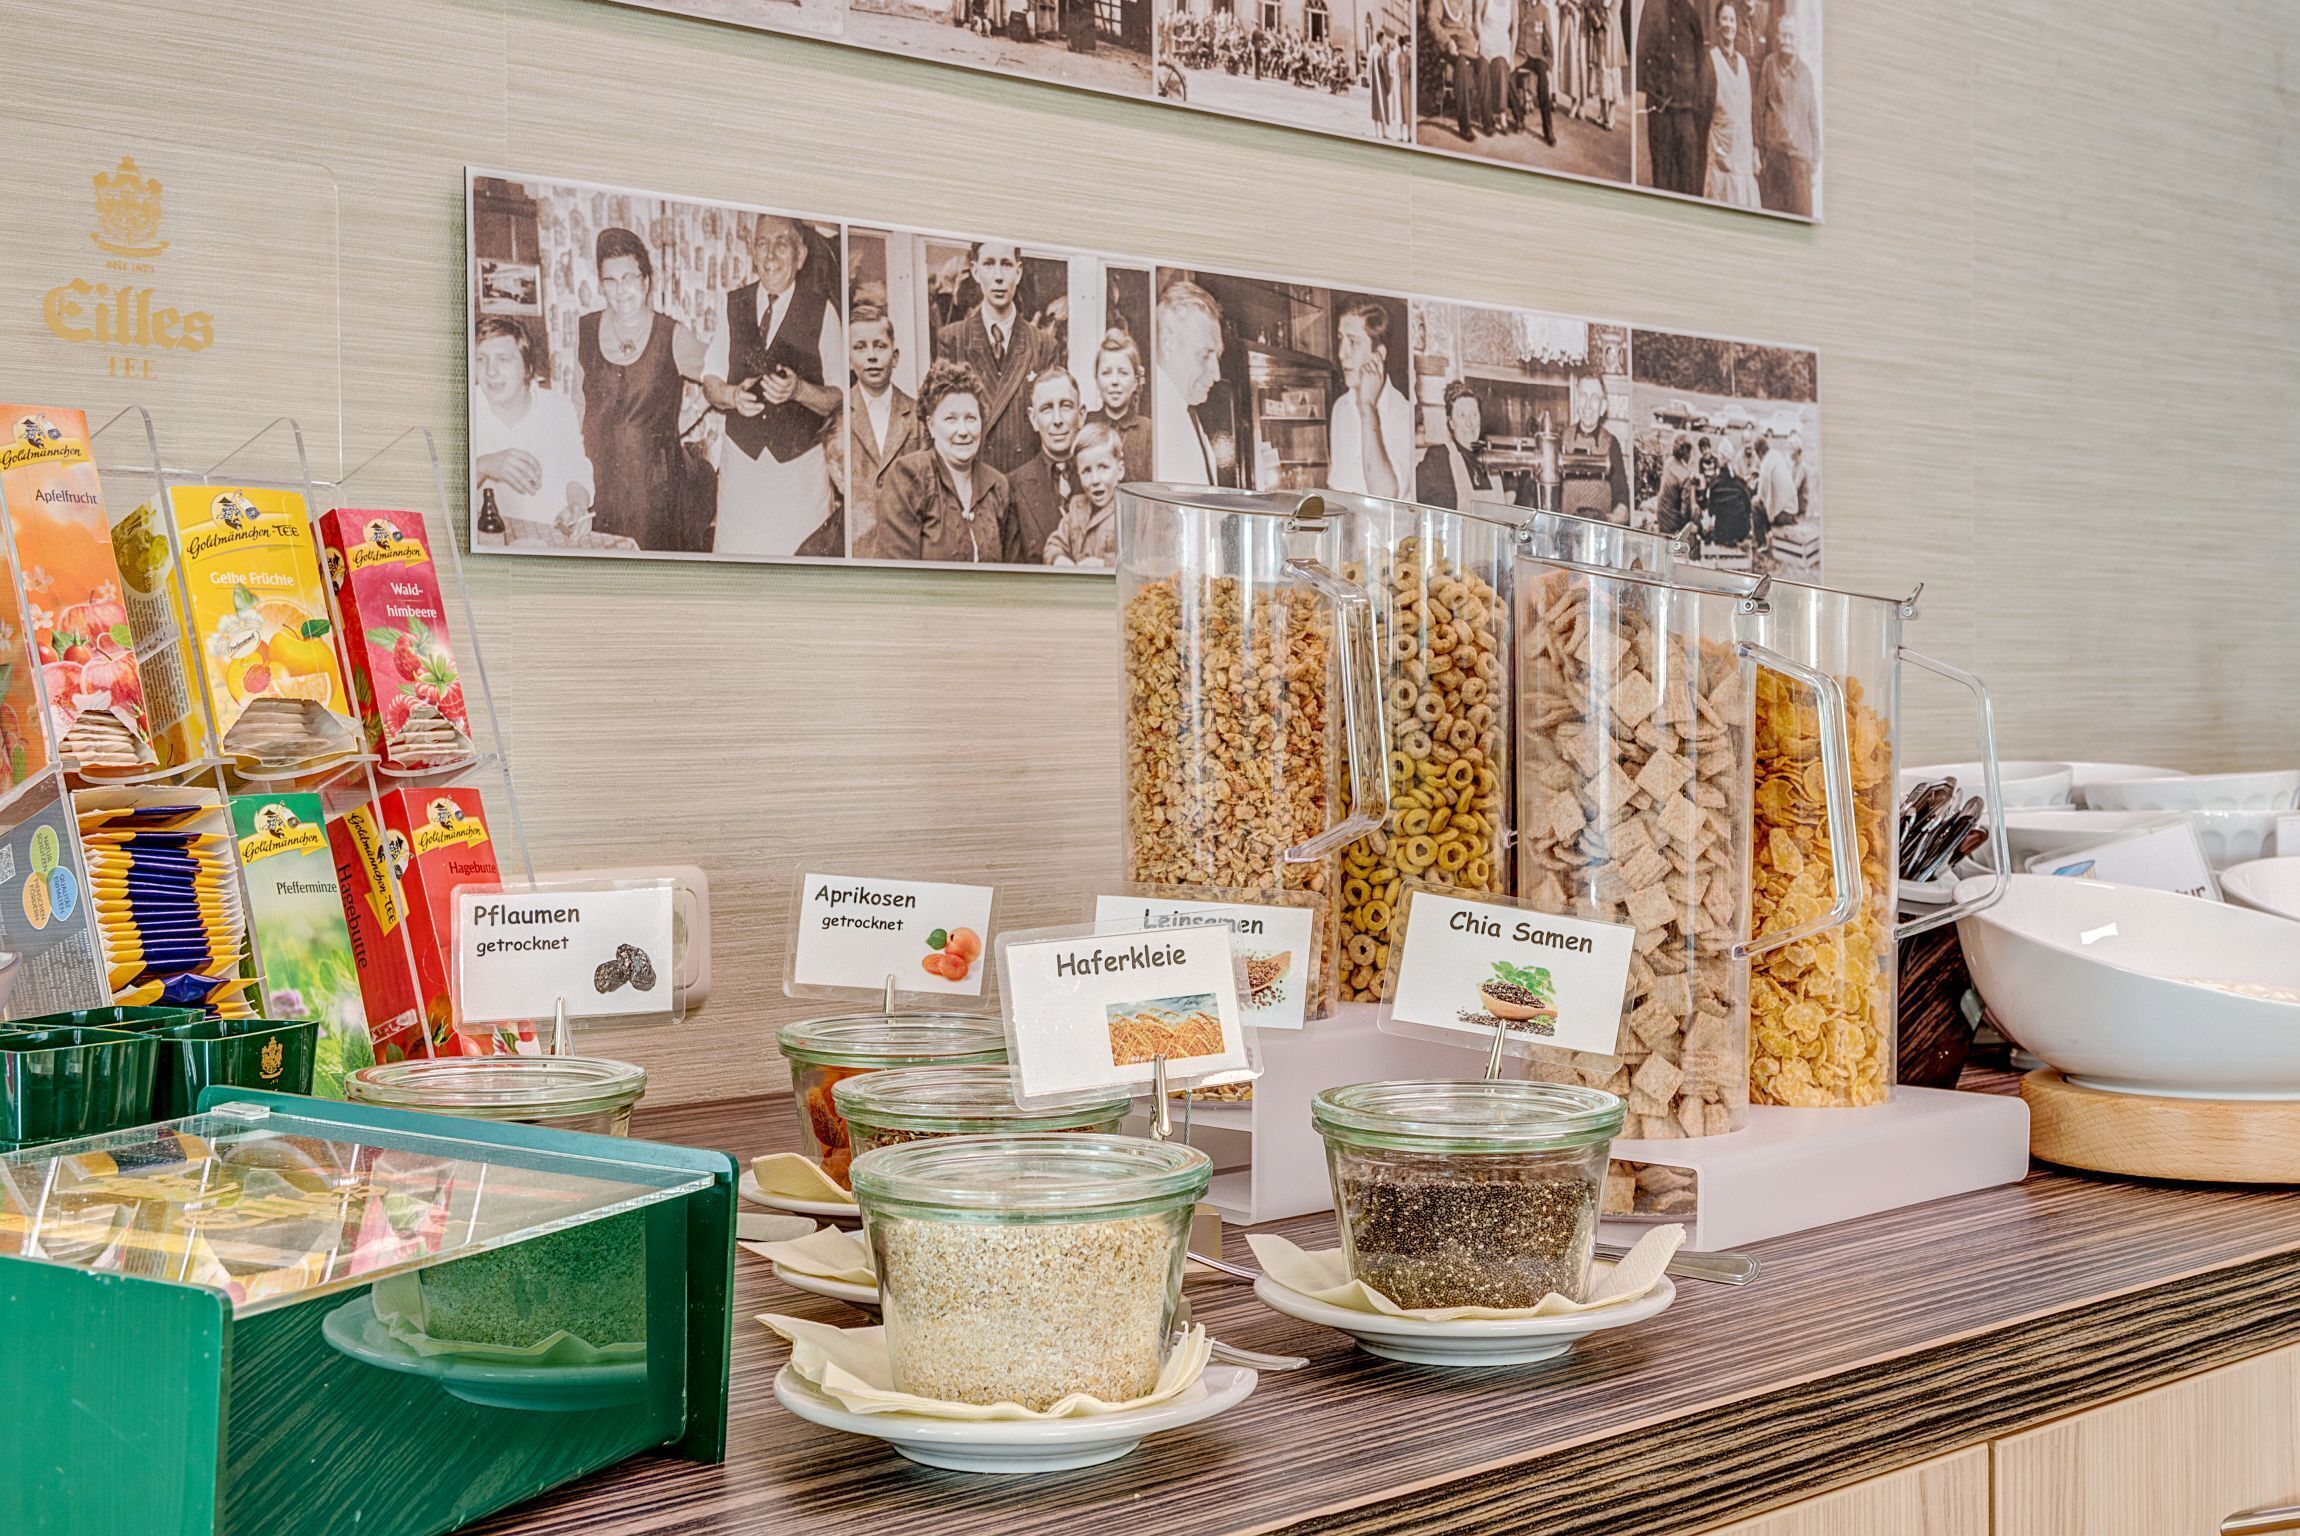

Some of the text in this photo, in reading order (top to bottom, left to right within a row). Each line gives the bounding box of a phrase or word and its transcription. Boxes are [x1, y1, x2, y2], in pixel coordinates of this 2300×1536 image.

[43, 277, 215, 352] Eilles
[35, 488, 98, 504] Apfelfrucht
[209, 571, 295, 587] Gelbe Früchte
[390, 582, 423, 596] Wald-
[386, 604, 437, 618] himbeere
[449, 861, 498, 876] Hagebutte
[276, 881, 338, 895] Pfefferminze
[814, 884, 917, 910] Aprikosen
[337, 863, 368, 969] Hagebutte
[473, 904, 580, 927] Pflaumen
[821, 914, 905, 932] getrocknet
[1449, 911, 1594, 955] Chia Samen
[476, 935, 570, 957] getrocknet
[1056, 942, 1187, 978] Haferkleie
